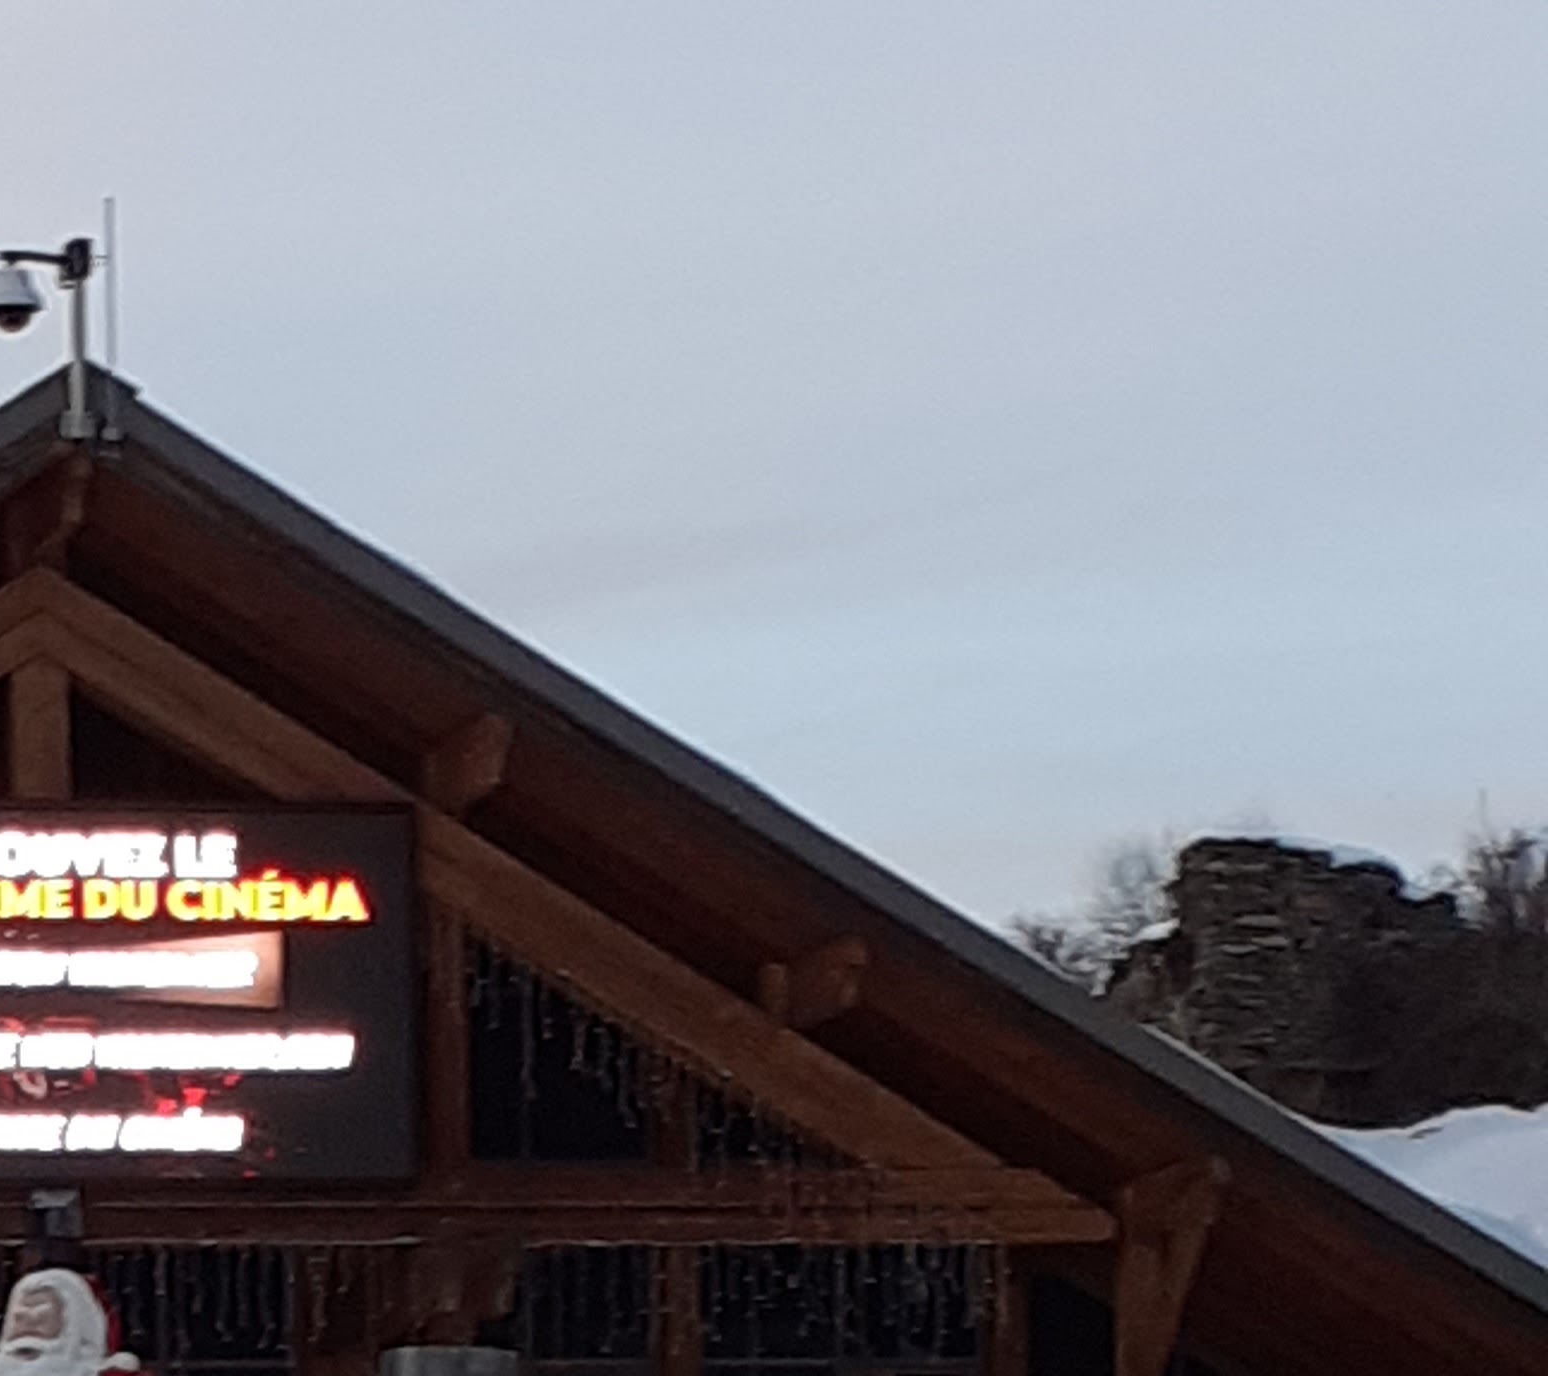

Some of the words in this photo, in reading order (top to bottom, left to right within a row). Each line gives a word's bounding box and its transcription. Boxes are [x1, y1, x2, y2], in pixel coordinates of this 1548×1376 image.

[173, 832, 239, 878] LE
[82, 879, 159, 920] DU
[165, 868, 371, 922] CINÉMA
